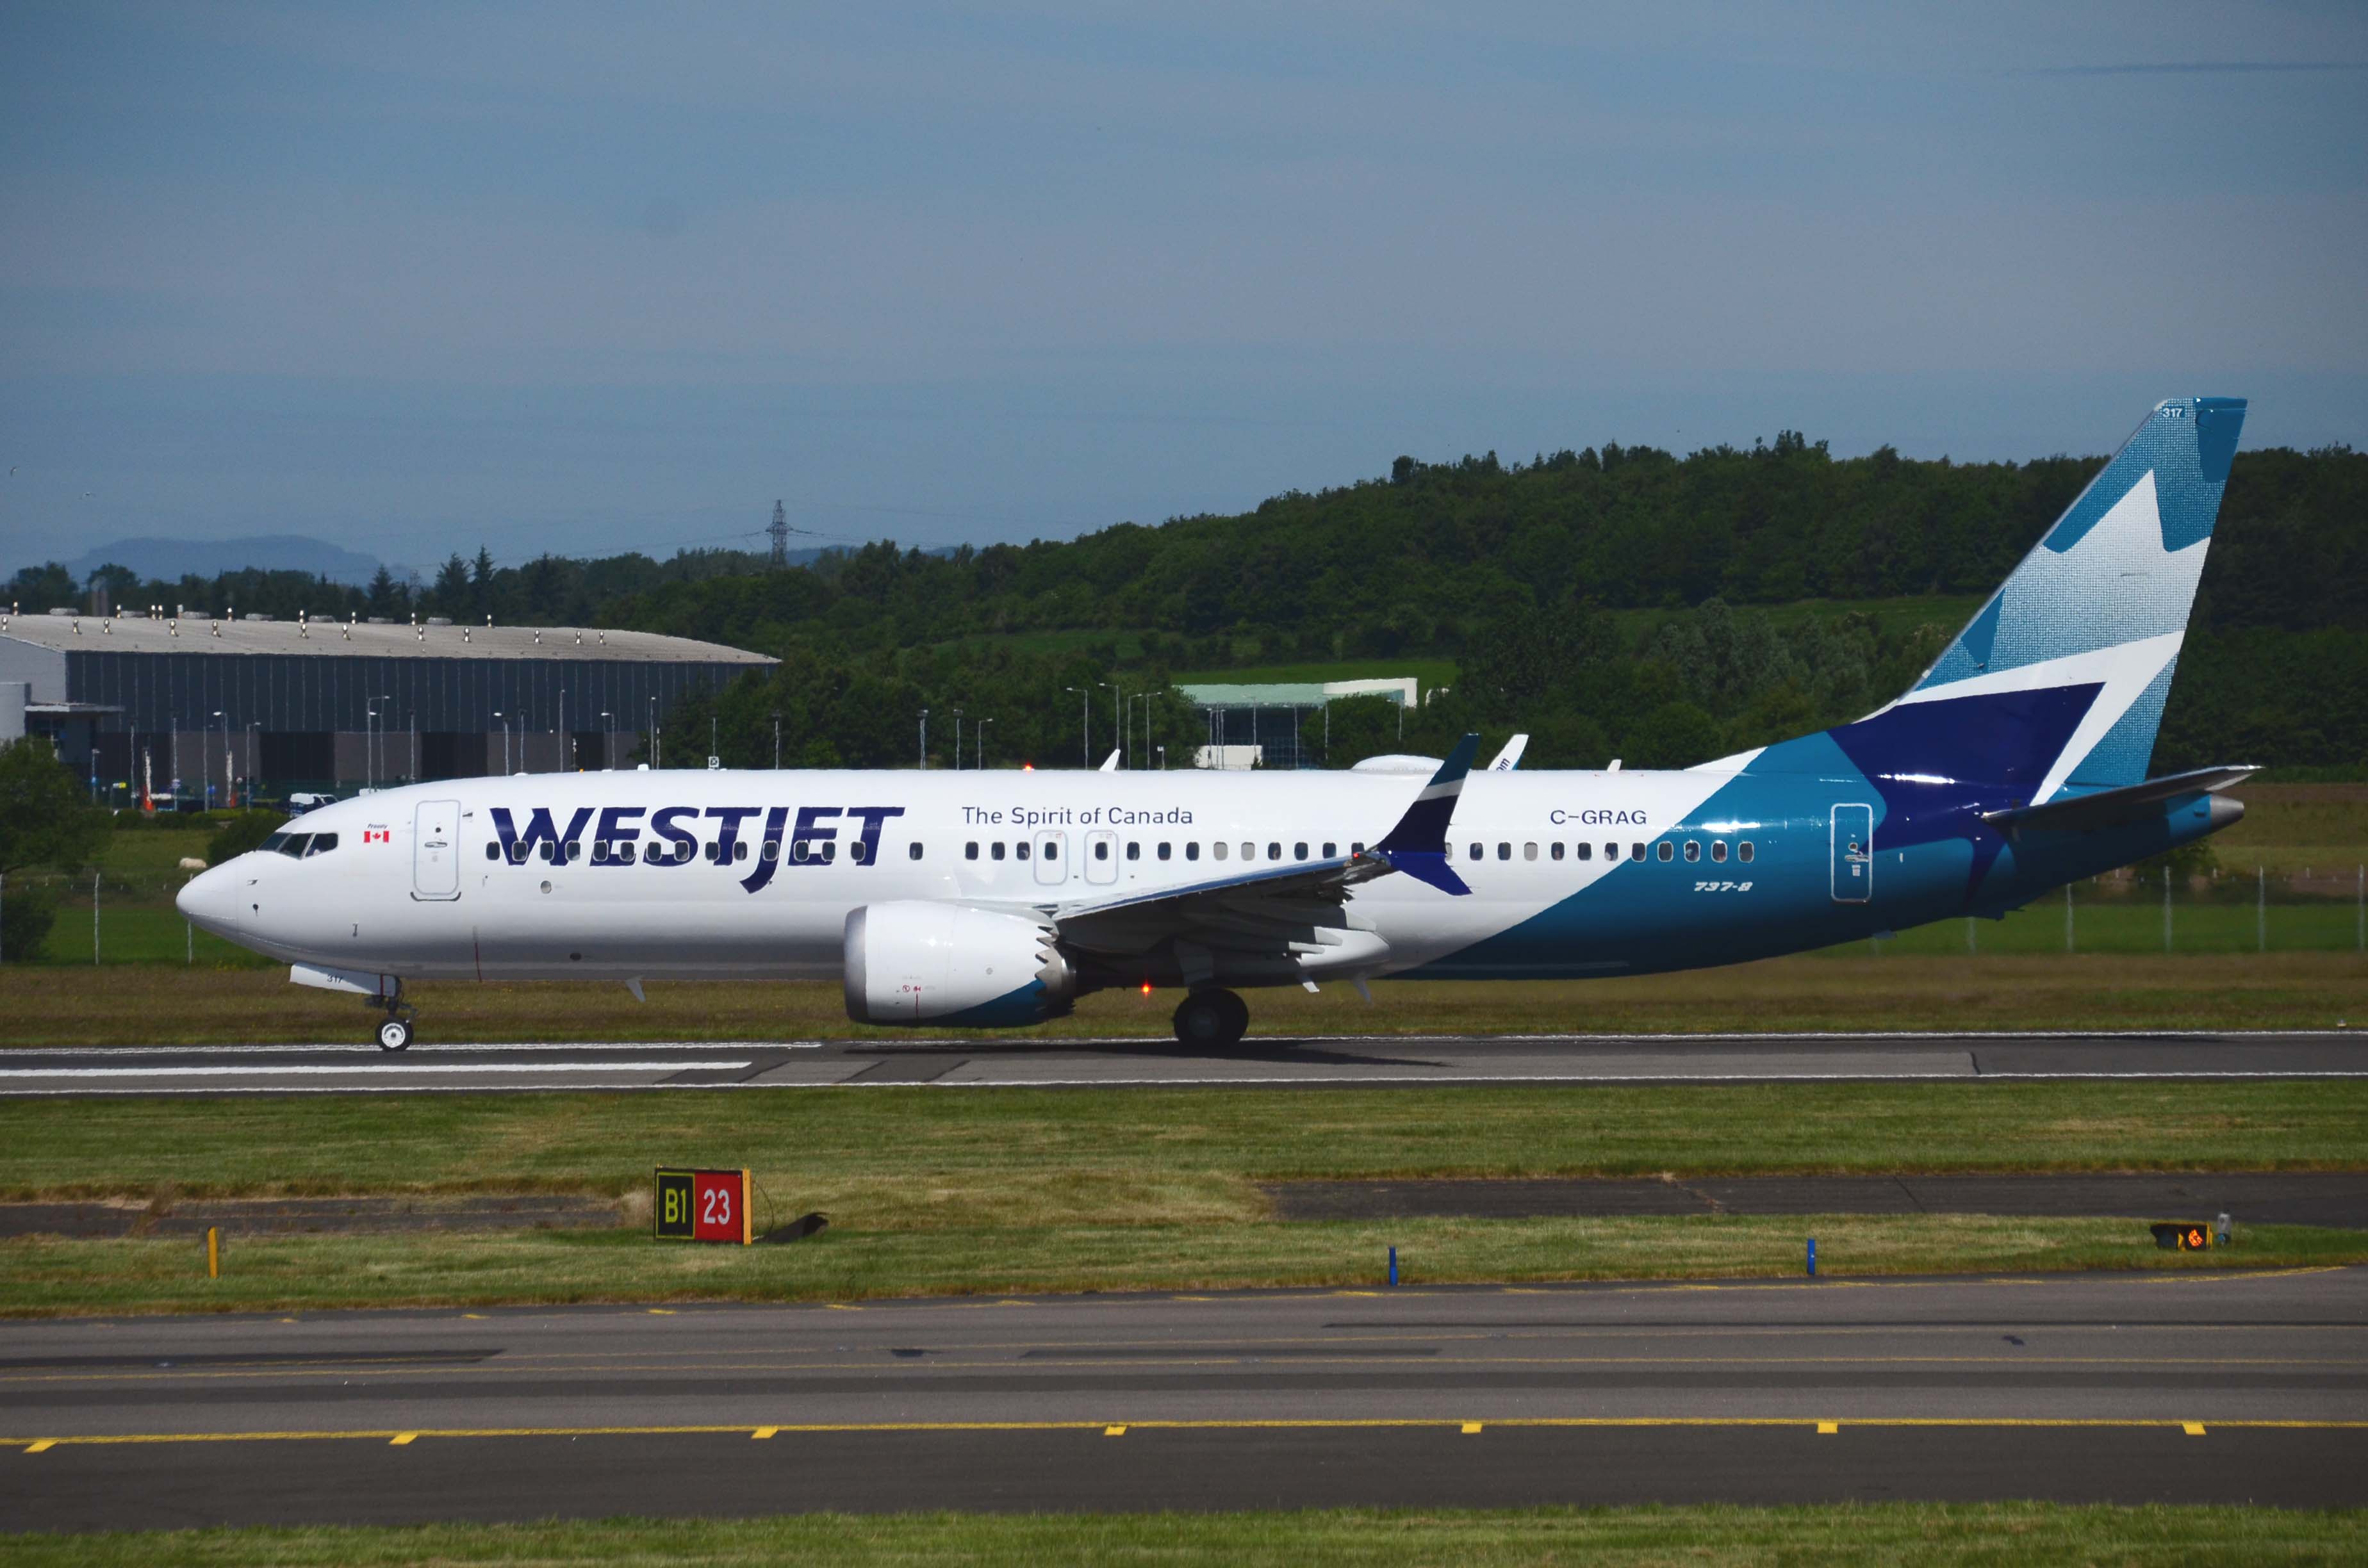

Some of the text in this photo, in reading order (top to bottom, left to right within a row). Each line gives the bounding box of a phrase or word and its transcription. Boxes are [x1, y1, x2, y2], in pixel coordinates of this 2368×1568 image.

[2162, 407, 2183, 418] 317
[962, 806, 1193, 829] The Spirit of Canada
[1550, 810, 1647, 825] C-GRAG
[489, 806, 905, 895] WESTJET
[1694, 881, 1753, 892] 737-8
[665, 1188, 730, 1225] B1 23
